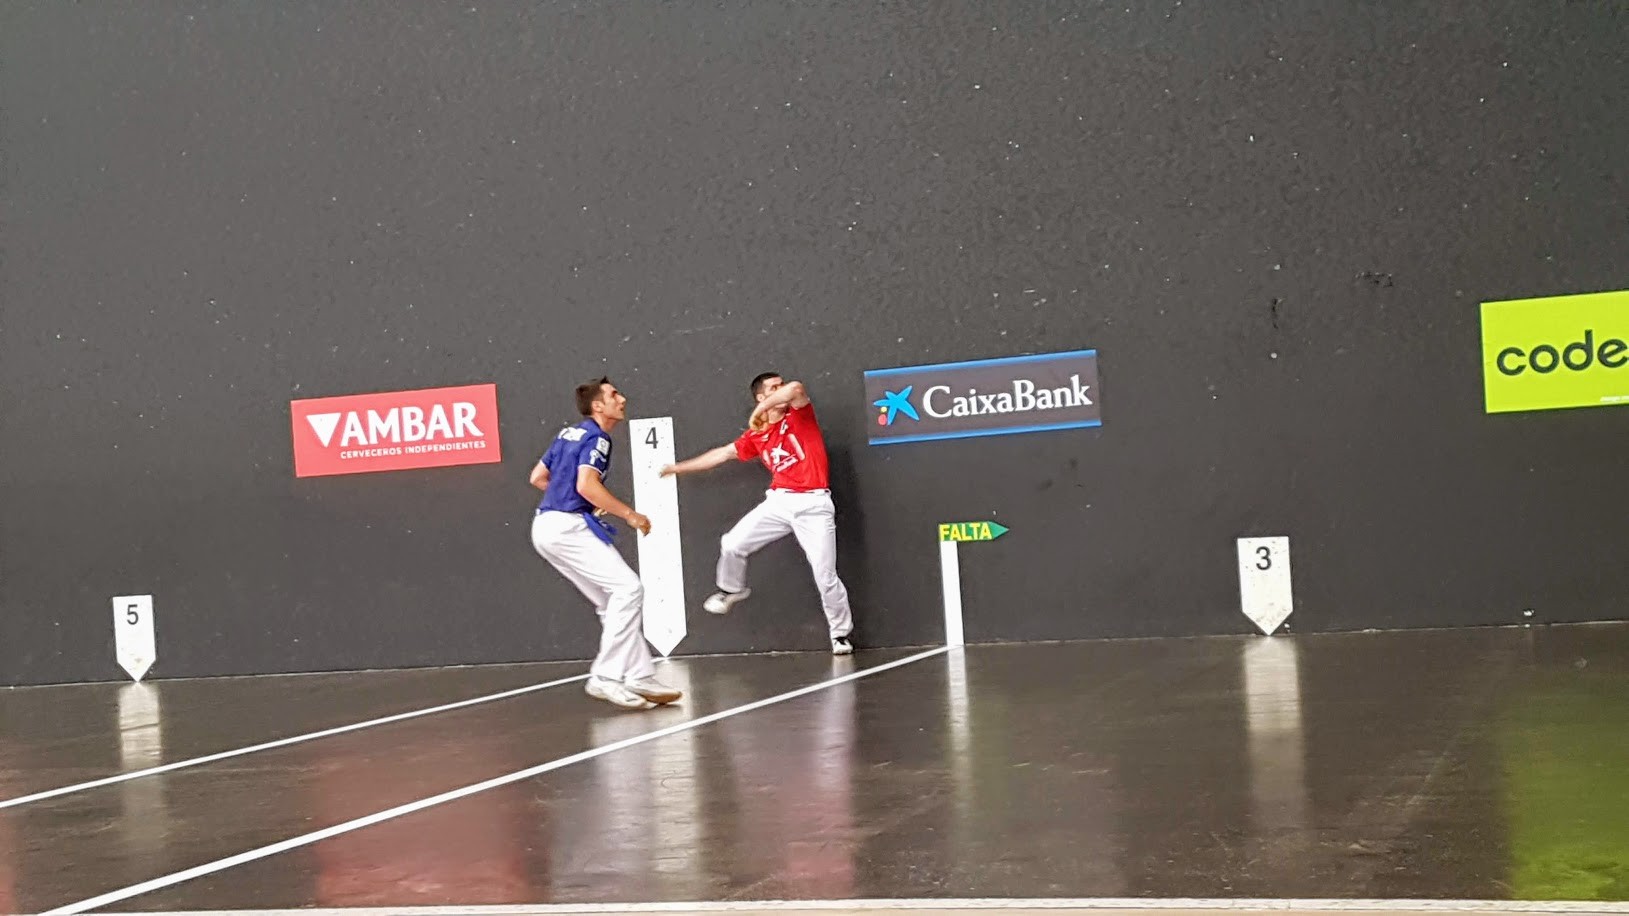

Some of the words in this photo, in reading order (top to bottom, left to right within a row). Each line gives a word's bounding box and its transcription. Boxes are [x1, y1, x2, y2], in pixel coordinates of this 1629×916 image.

[922, 374, 1093, 418] CaixaBank
[340, 402, 484, 446] AMBAR
[645, 427, 659, 449] 4
[340, 447, 402, 459] CERVECEROS
[405, 440, 486, 454] INDEPENDIENTES
[939, 522, 992, 541] FALTA
[1256, 546, 1272, 571] 3
[127, 604, 139, 625] 5
